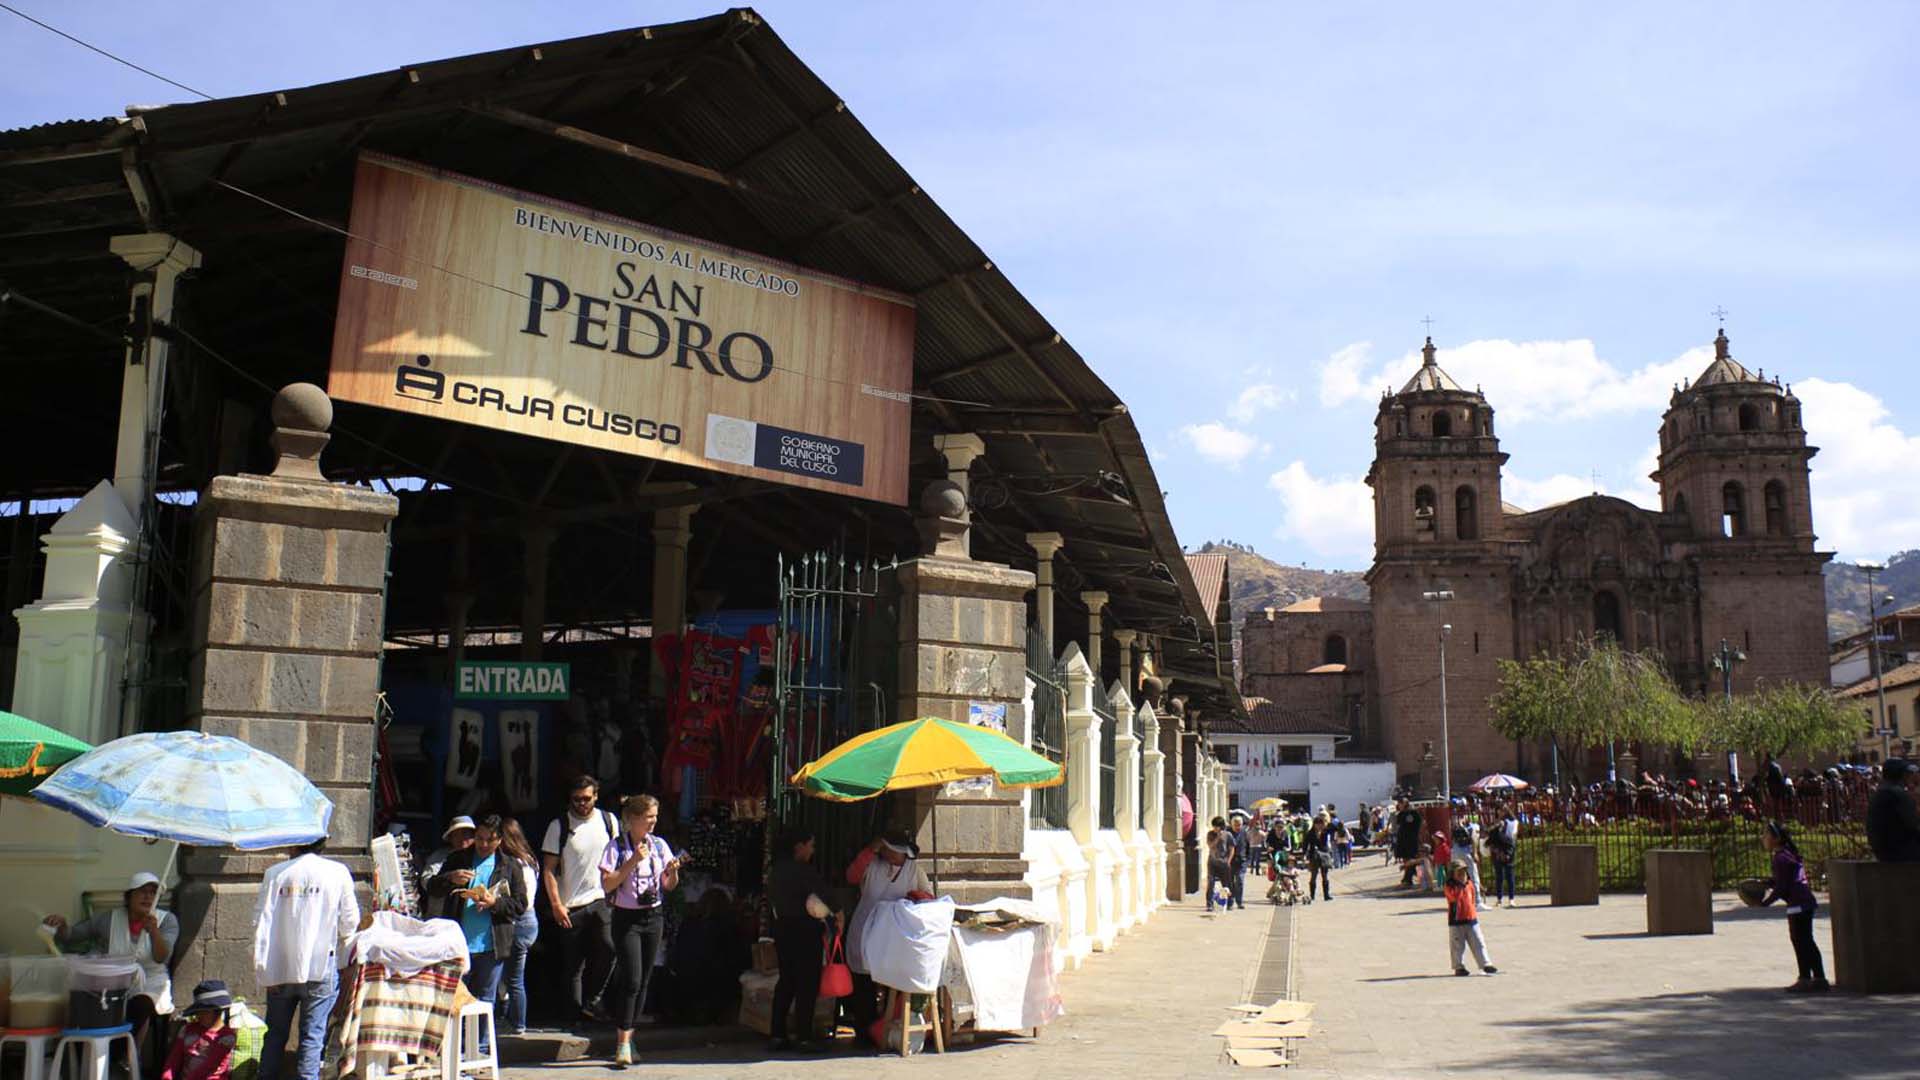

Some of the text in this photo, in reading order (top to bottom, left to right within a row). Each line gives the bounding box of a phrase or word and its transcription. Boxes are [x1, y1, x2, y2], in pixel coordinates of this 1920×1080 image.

[515, 208, 799, 296] BIENVENIDOS AL MERCADO
[612, 261, 704, 317] SAN
[520, 272, 774, 383] PEDRO
[452, 381, 681, 445] CAJA CUSCO
[780, 435, 841, 456] GOBIERNO
[780, 446, 835, 465] MUNICIPAL
[780, 455, 838, 475] DEL CUSCO
[459, 666, 567, 694] ENTRADA
